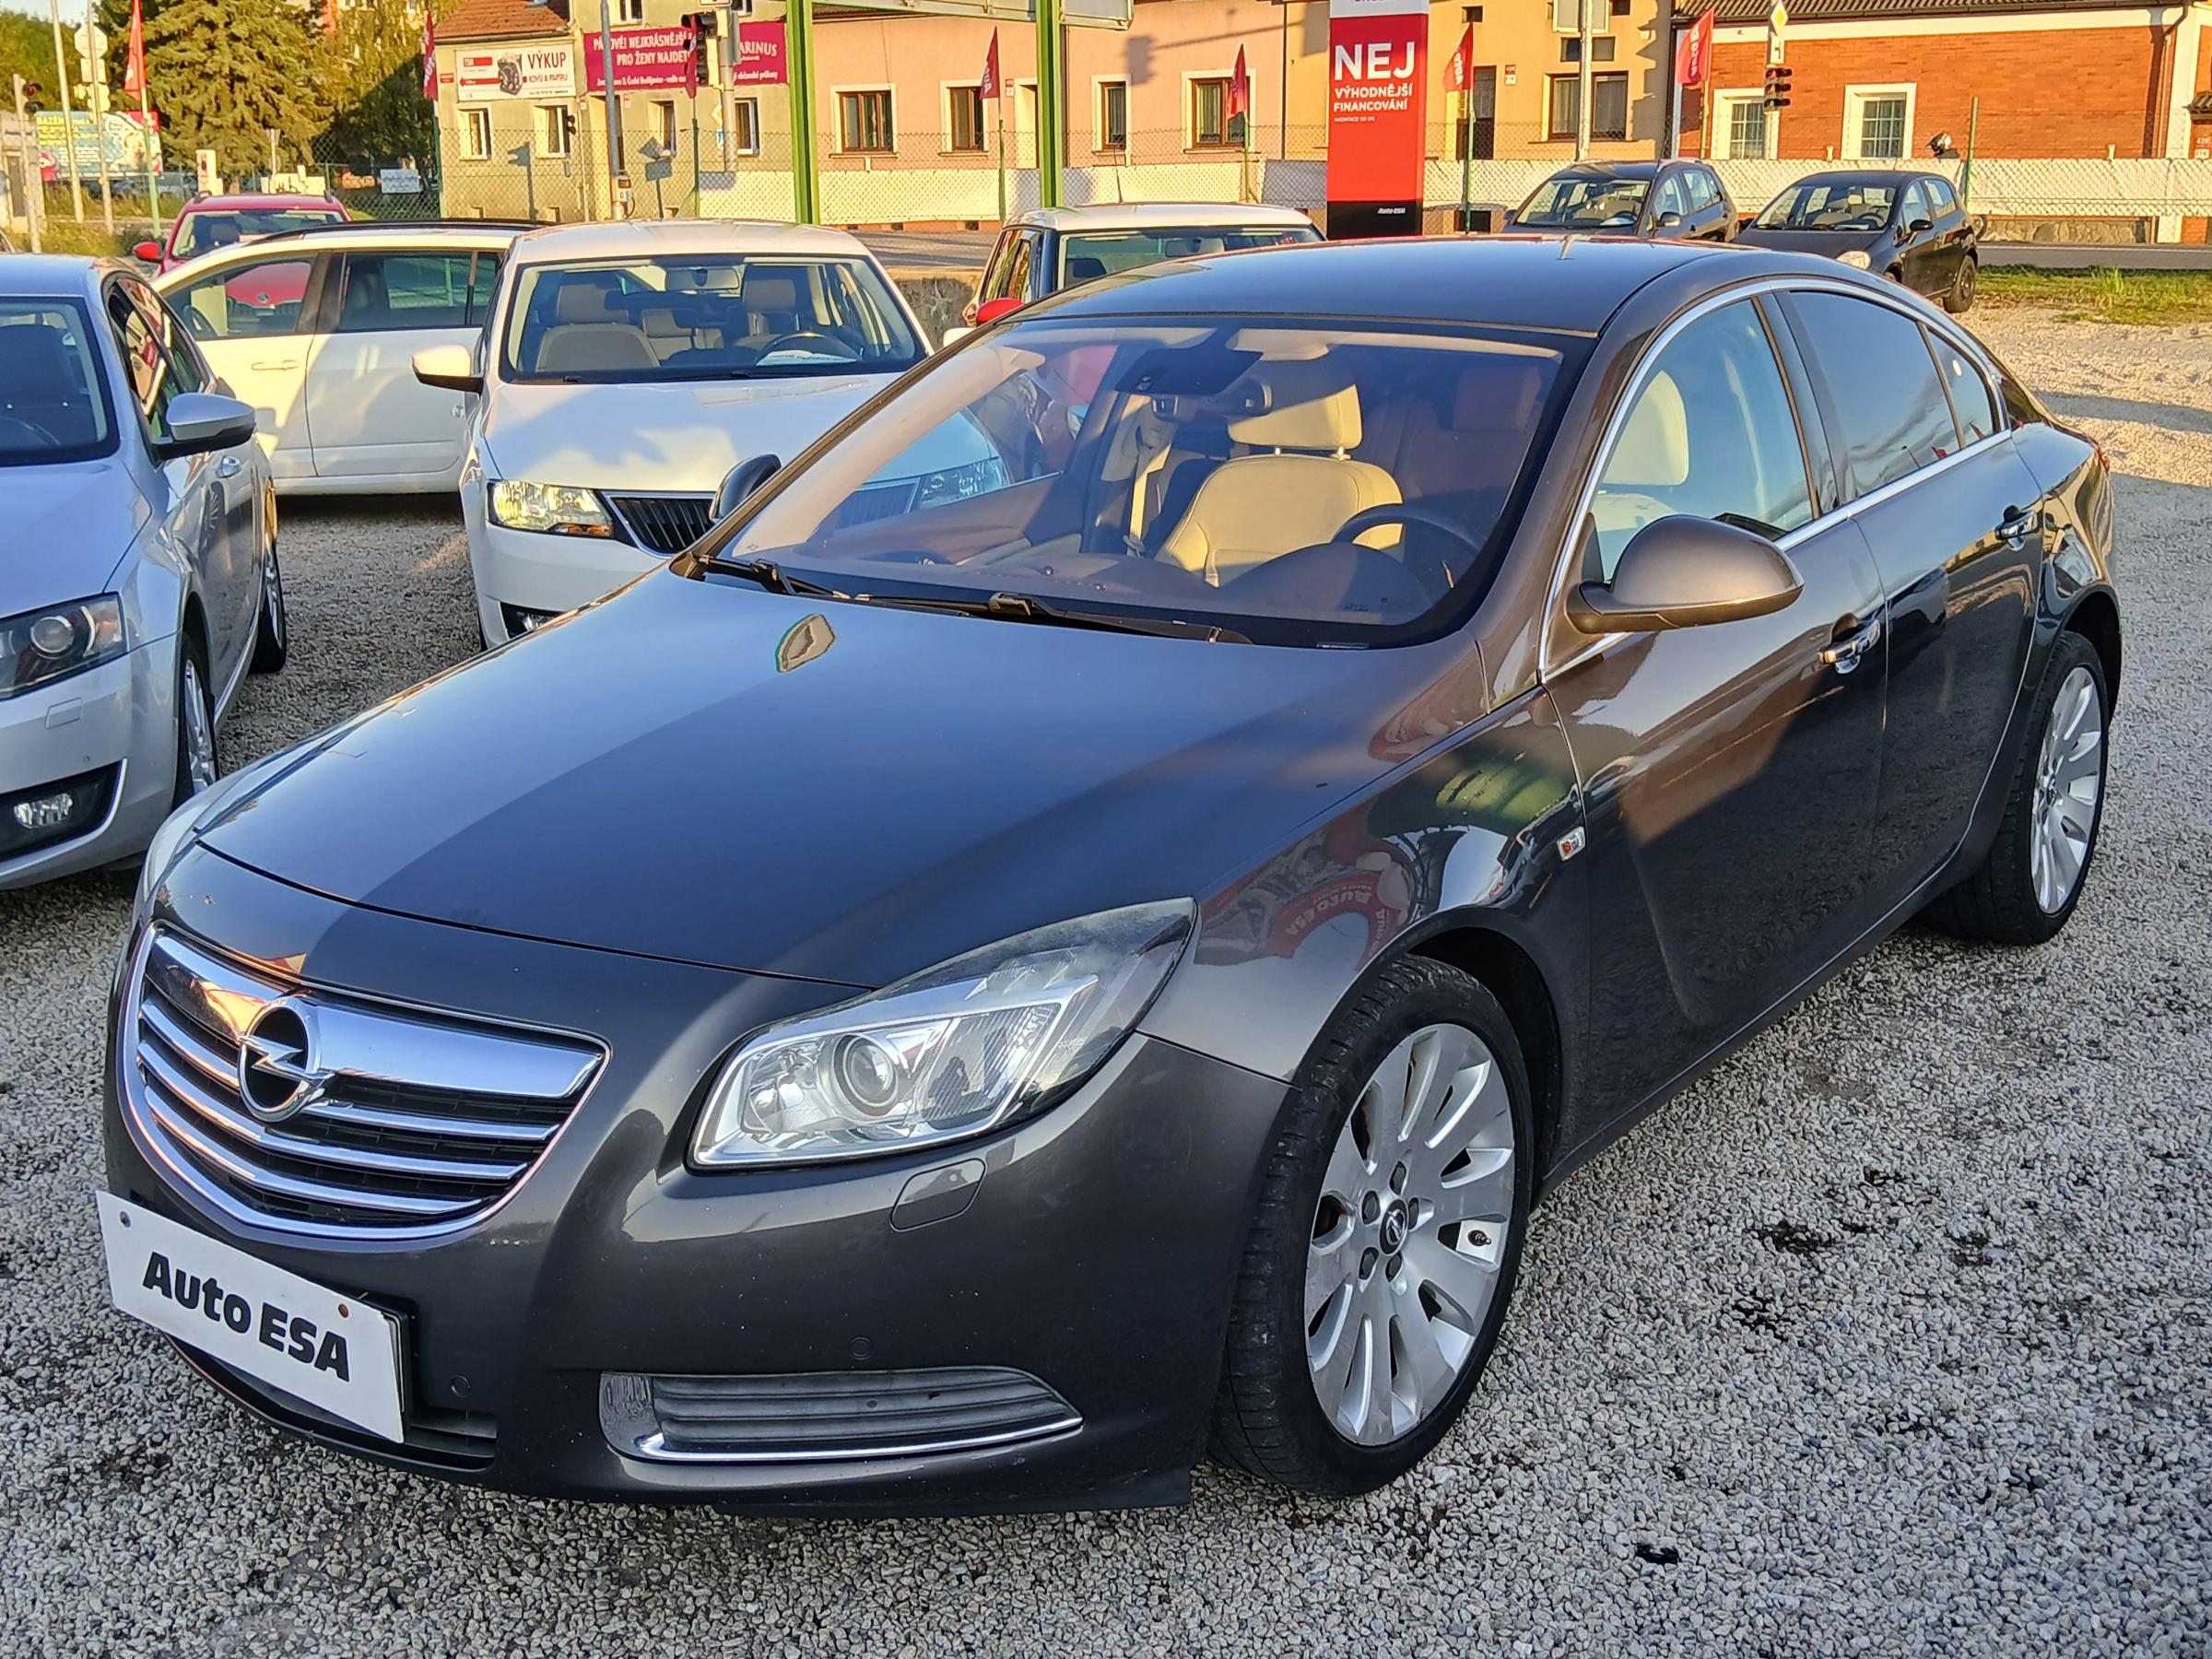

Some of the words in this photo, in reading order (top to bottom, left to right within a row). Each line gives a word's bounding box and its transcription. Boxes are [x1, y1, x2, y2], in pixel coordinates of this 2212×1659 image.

[593, 34, 628, 51] PÁOVÉ!
[739, 41, 778, 57] ARINUS
[527, 50, 567, 69] VÝKUP
[617, 53, 634, 65] PRO
[635, 51, 655, 65] ŽENY
[1334, 41, 1415, 81] NEJ
[1335, 83, 1413, 99] VÝHODNĚJŠÍ
[1334, 98, 1408, 112] FINANCOVÁNÍ
[142, 1251, 252, 1335] Auto
[259, 1301, 350, 1382] ESA
